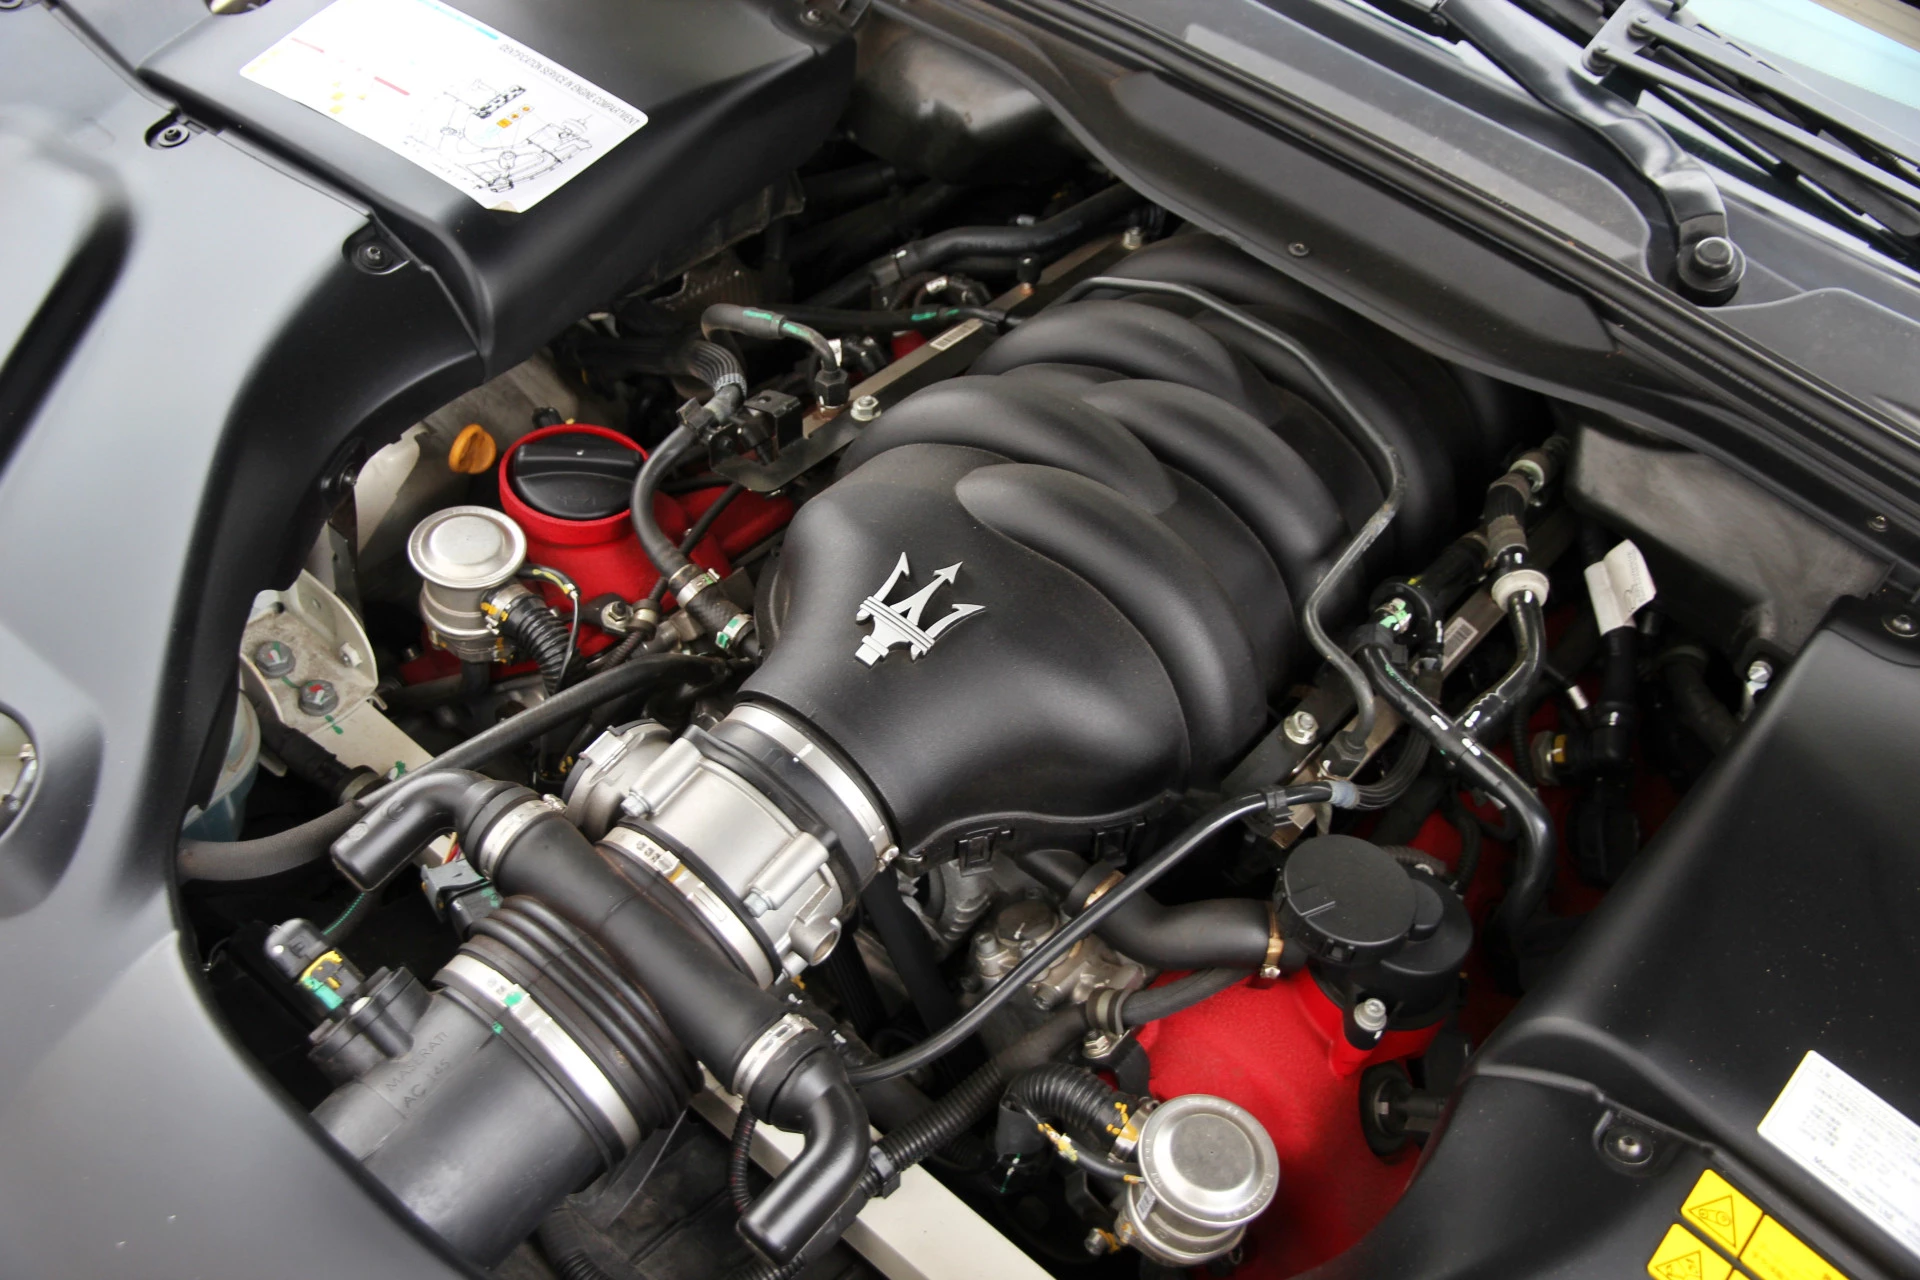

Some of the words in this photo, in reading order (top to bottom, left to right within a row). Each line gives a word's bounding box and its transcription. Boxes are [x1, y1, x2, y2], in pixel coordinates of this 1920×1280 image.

[540, 66, 566, 83] SERVICE
[570, 83, 594, 100] ENGINE
[592, 95, 640, 126] COMPARTMENT
[385, 1031, 447, 1091] MASERATI
[404, 1084, 426, 1107] AC
